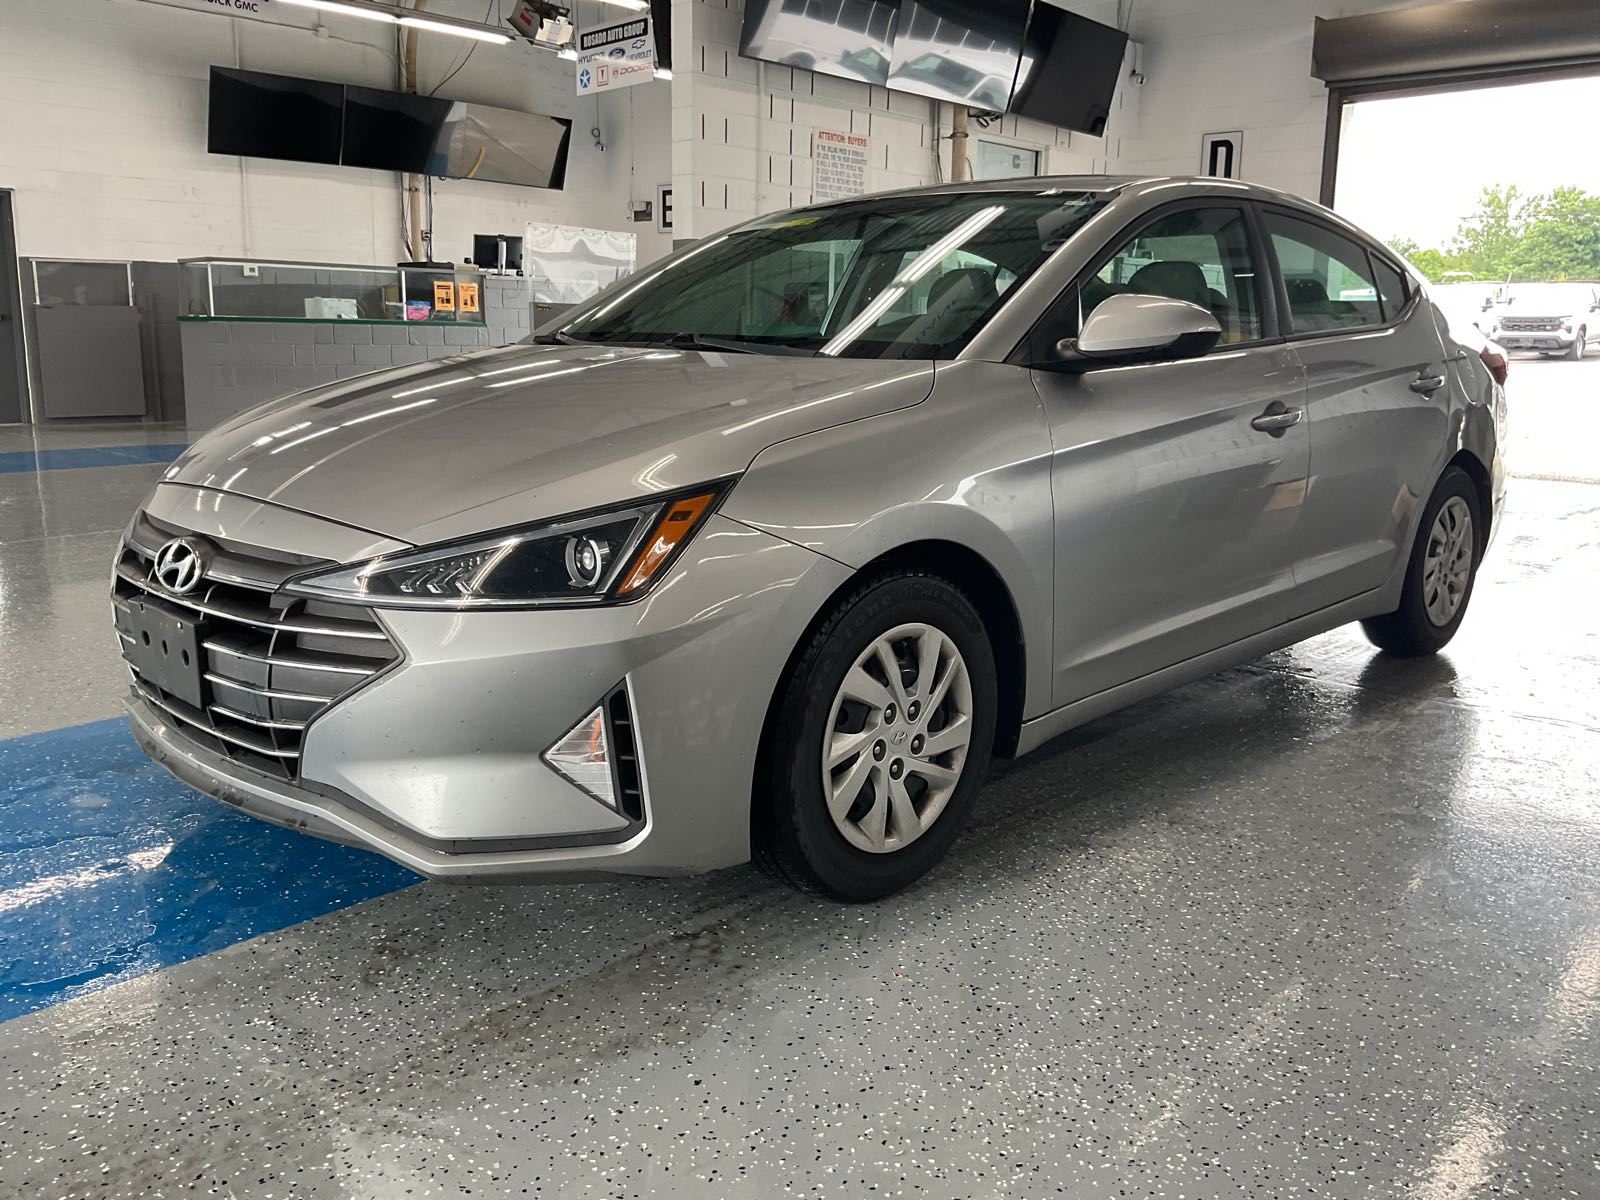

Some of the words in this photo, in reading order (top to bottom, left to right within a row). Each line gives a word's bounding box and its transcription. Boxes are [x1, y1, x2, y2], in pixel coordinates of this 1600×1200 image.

[234, 0, 258, 13] GMC
[583, 31, 607, 48] ROSADO
[607, 27, 623, 42] AUTO
[624, 22, 645, 37] GROUP
[620, 62, 652, 75] DODGE
[848, 136, 867, 147] BUYERS
[1012, 155, 1021, 169] C
